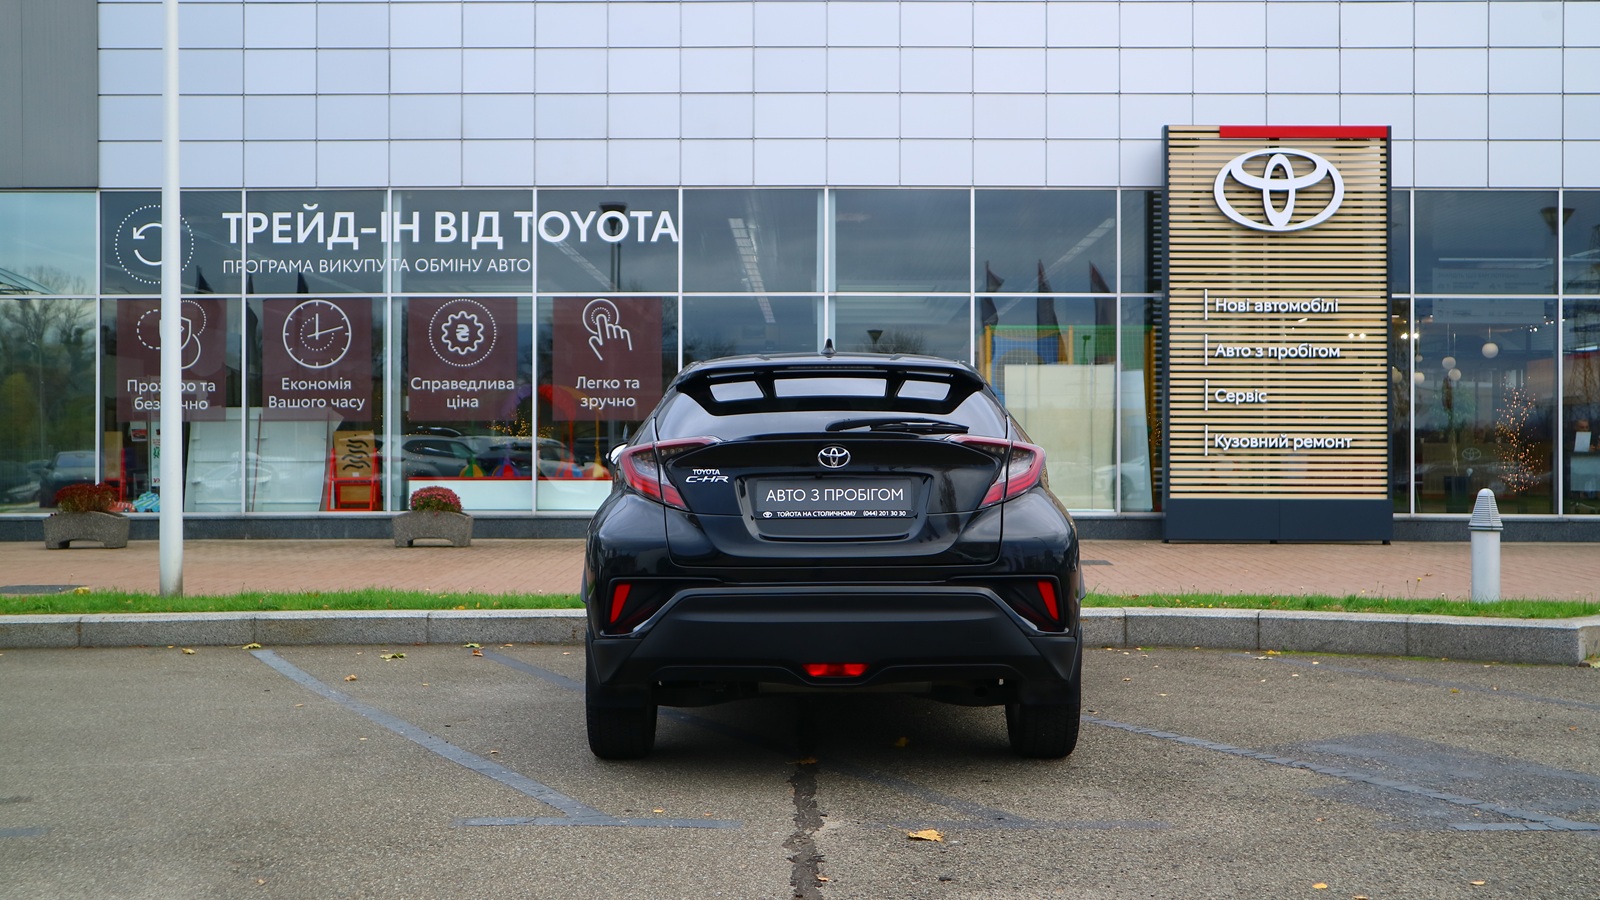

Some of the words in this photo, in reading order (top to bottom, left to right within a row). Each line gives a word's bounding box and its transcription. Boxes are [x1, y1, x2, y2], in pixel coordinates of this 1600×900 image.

[222, 203, 419, 250] ТРЕЙД-ІН
[434, 211, 503, 250] ВІД
[513, 210, 679, 243] TOYOTA
[223, 258, 314, 273] ПРОГРАМА
[319, 258, 387, 273] ВИКУПУ
[390, 258, 410, 272] ТА
[415, 258, 482, 272] ОБМІНУ
[487, 258, 531, 272] АВТО
[1215, 298, 1250, 312] Нові
[1254, 298, 1339, 312] автомобілі
[1215, 343, 1251, 357] Авто
[1255, 346, 1264, 357] з
[1268, 343, 1340, 360] пробігом
[127, 379, 196, 395] Проо
[200, 382, 216, 392] та
[281, 377, 352, 390] Економія
[411, 377, 515, 393] Справедлива
[575, 376, 620, 389] Легко
[624, 379, 640, 389] та
[134, 397, 209, 410] безчно
[268, 395, 327, 408] Вашого
[330, 398, 365, 411] часу
[446, 395, 479, 410] ціна
[580, 397, 636, 410] зручно
[1215, 389, 1268, 405] Сервіс
[1214, 433, 1289, 451] Кузовний
[1293, 436, 1353, 451] ремонт
[692, 468, 721, 476] TOYOTA
[685, 475, 729, 484] C-HR
[765, 489, 807, 502] АВТО
[810, 489, 820, 502] З
[824, 488, 904, 501] ПРОБІГОМ
[776, 510, 801, 518] ТОЙОТА
